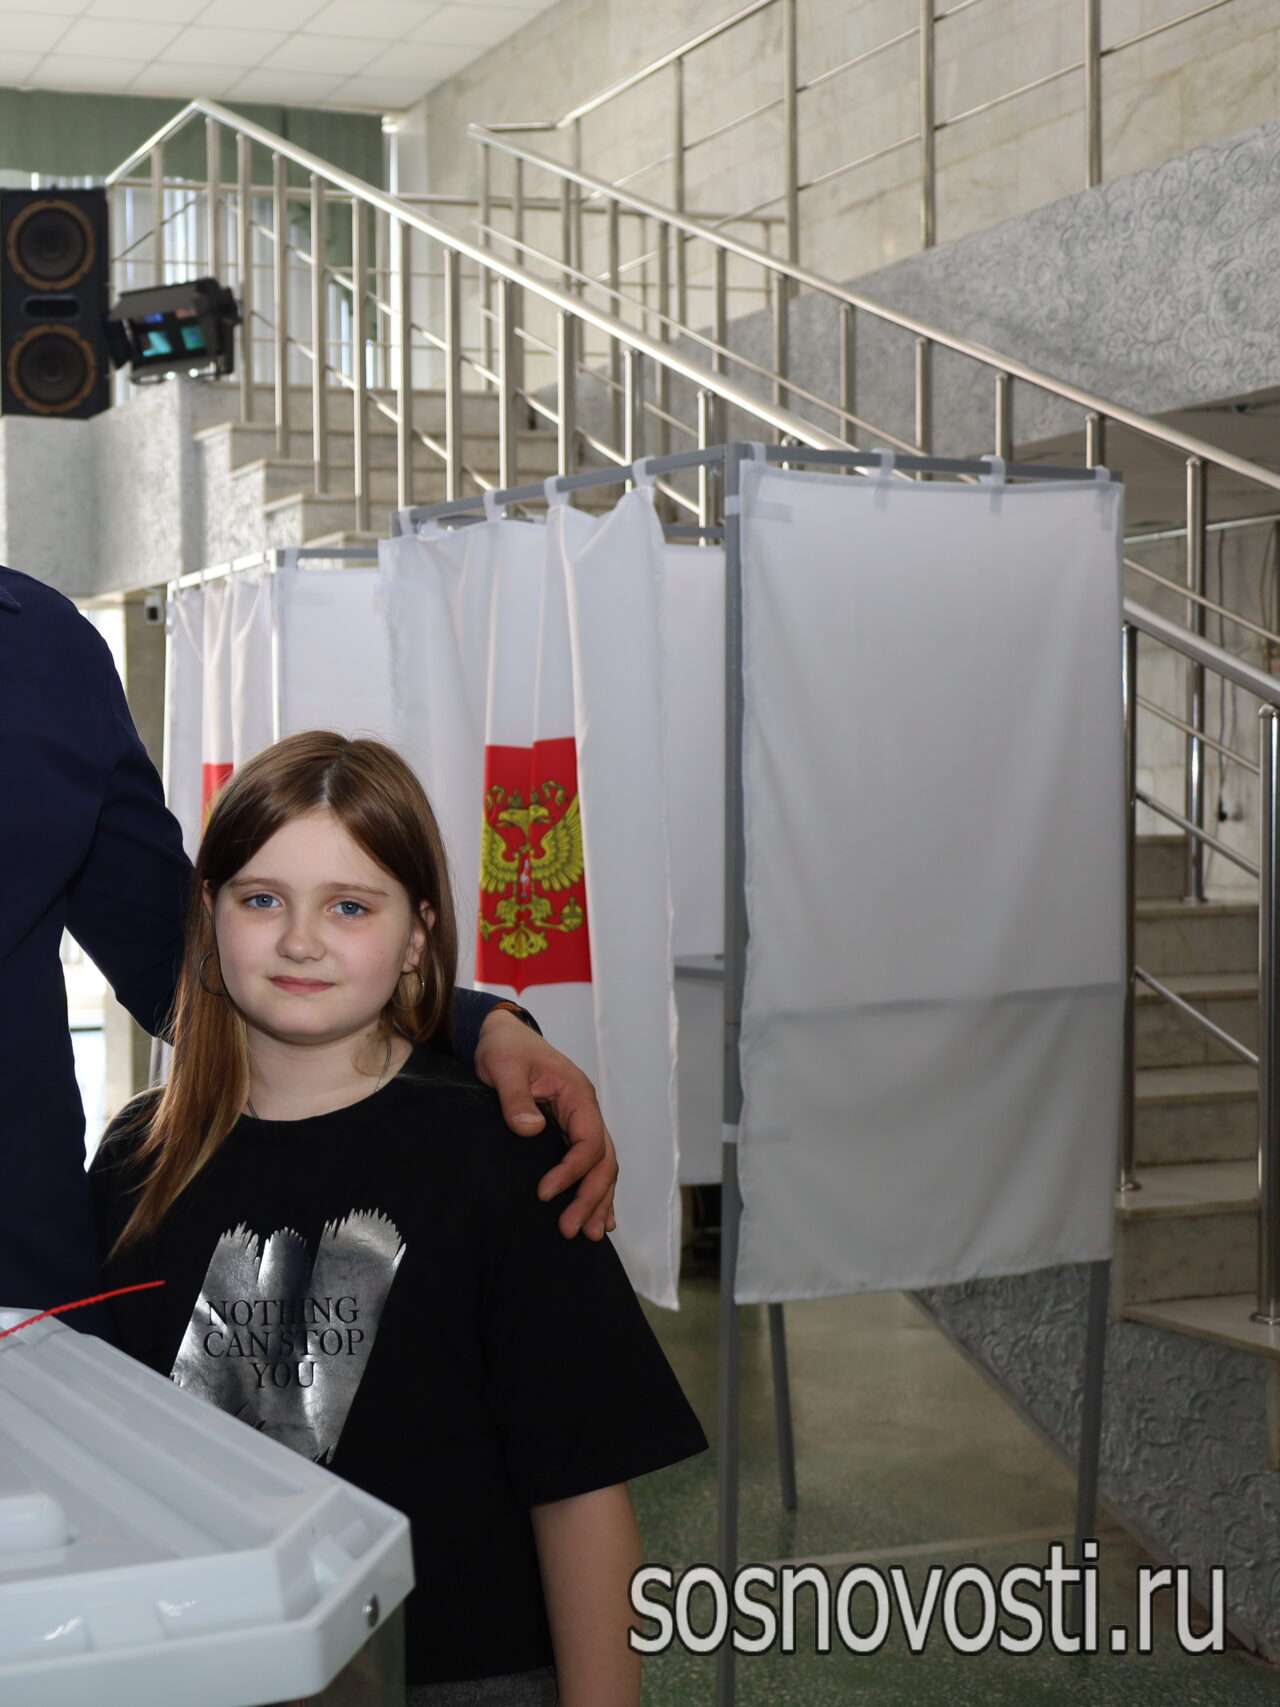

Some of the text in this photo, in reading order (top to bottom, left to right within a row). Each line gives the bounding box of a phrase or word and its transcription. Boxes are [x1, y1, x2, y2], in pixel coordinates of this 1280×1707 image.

[206, 1296, 360, 1327] NOTHING
[203, 1328, 365, 1358] CAN STOP
[251, 1360, 319, 1389] YOU
